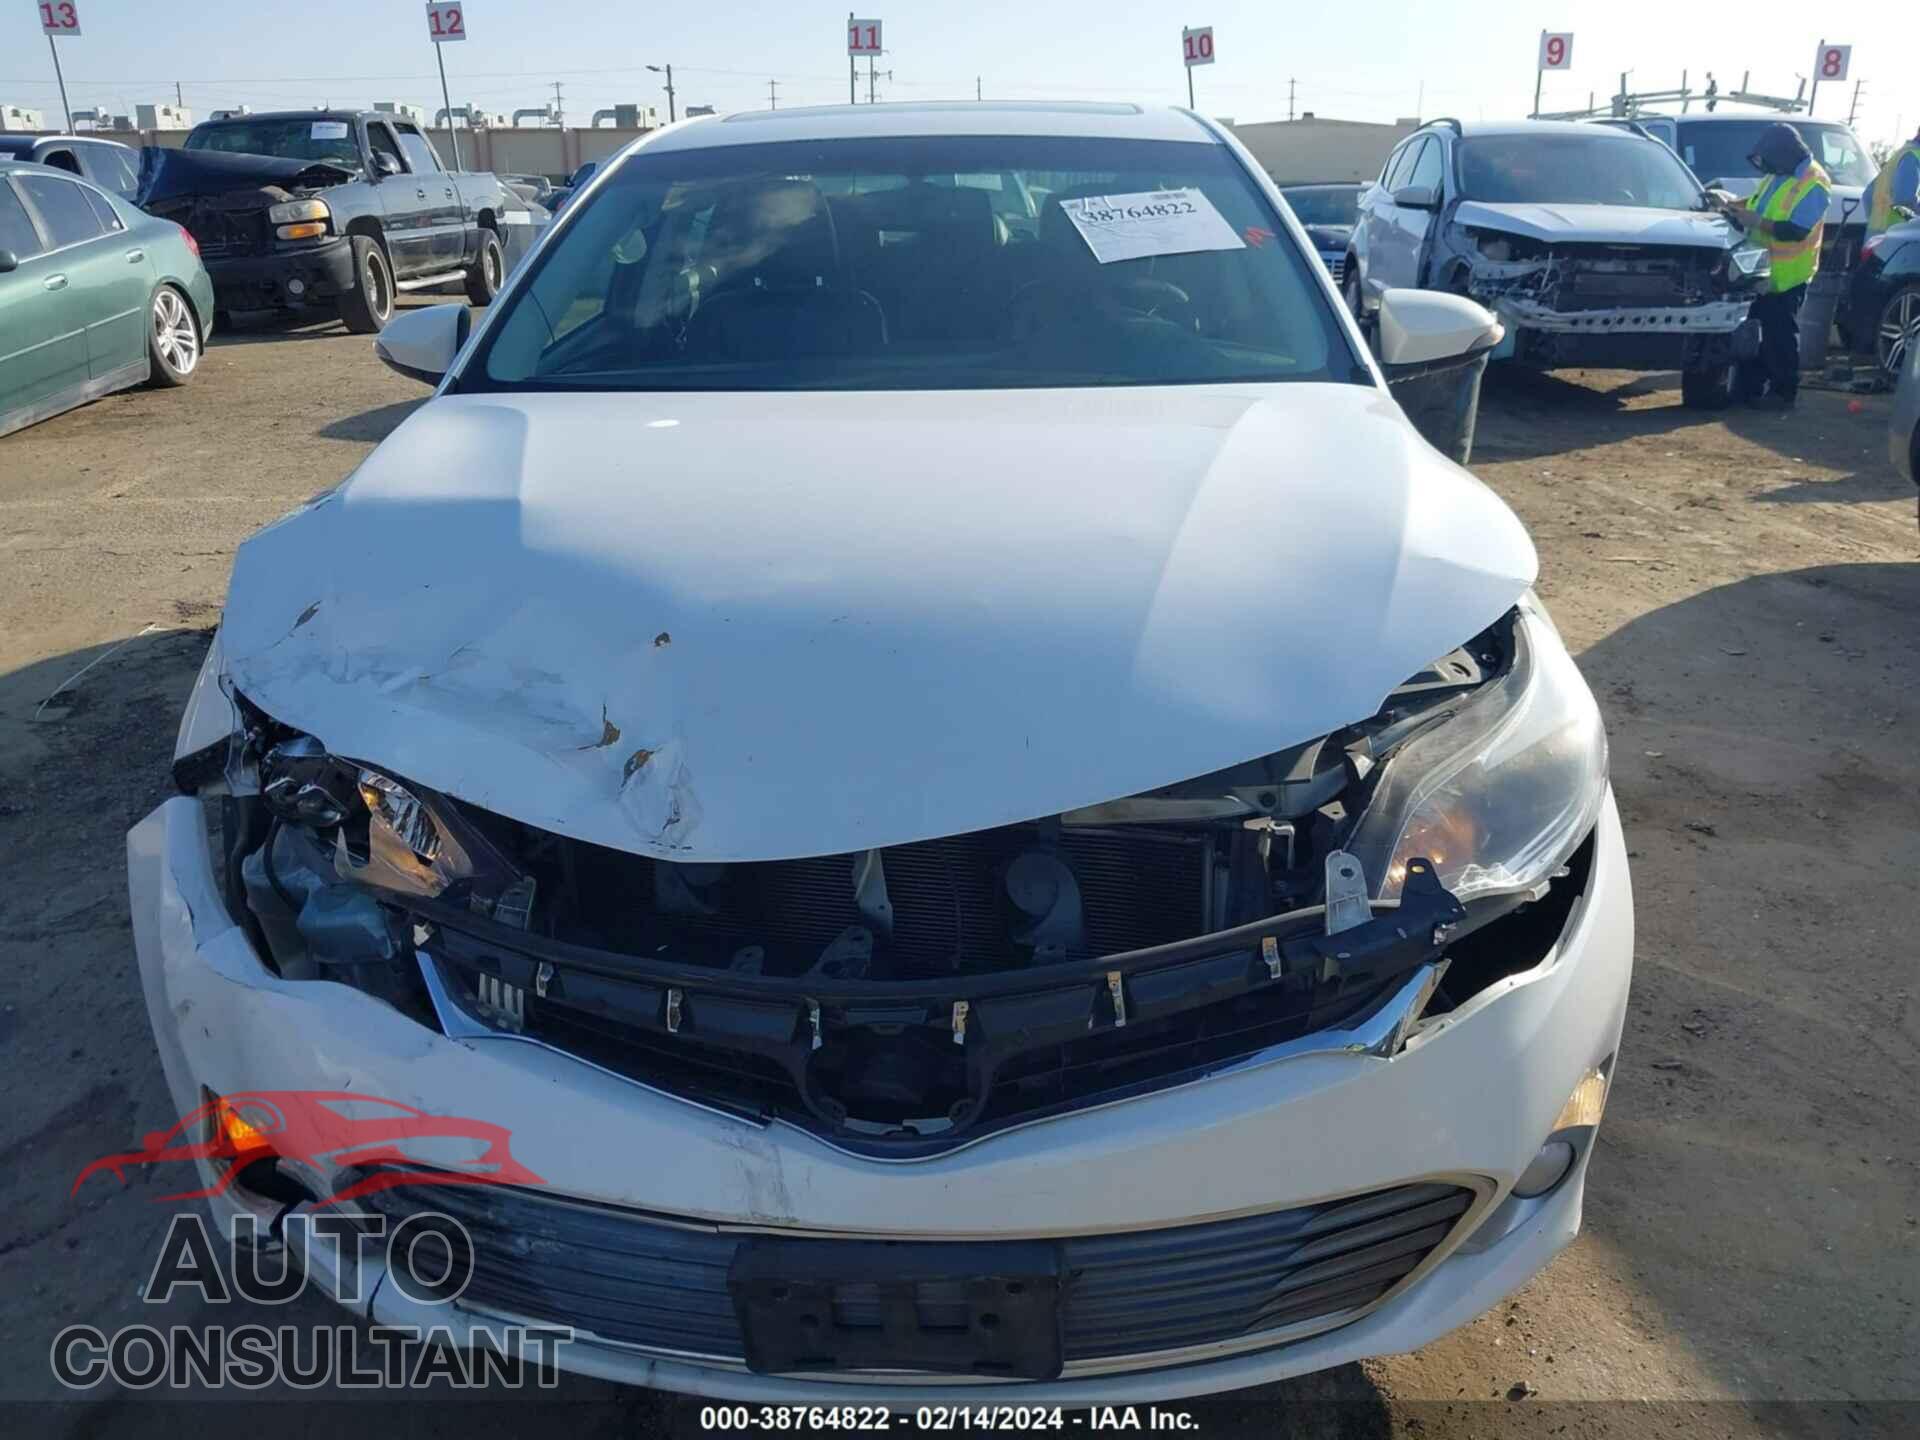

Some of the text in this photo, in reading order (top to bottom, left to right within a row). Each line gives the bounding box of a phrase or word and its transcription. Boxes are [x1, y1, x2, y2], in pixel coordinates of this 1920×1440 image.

[40, 3, 77, 28] 13
[429, 10, 463, 35] 12
[849, 26, 881, 49] 11
[1184, 34, 1213, 60] 10
[1547, 37, 1565, 65] 9
[1822, 49, 1841, 77] 8
[1085, 202, 1197, 222] 38764822
